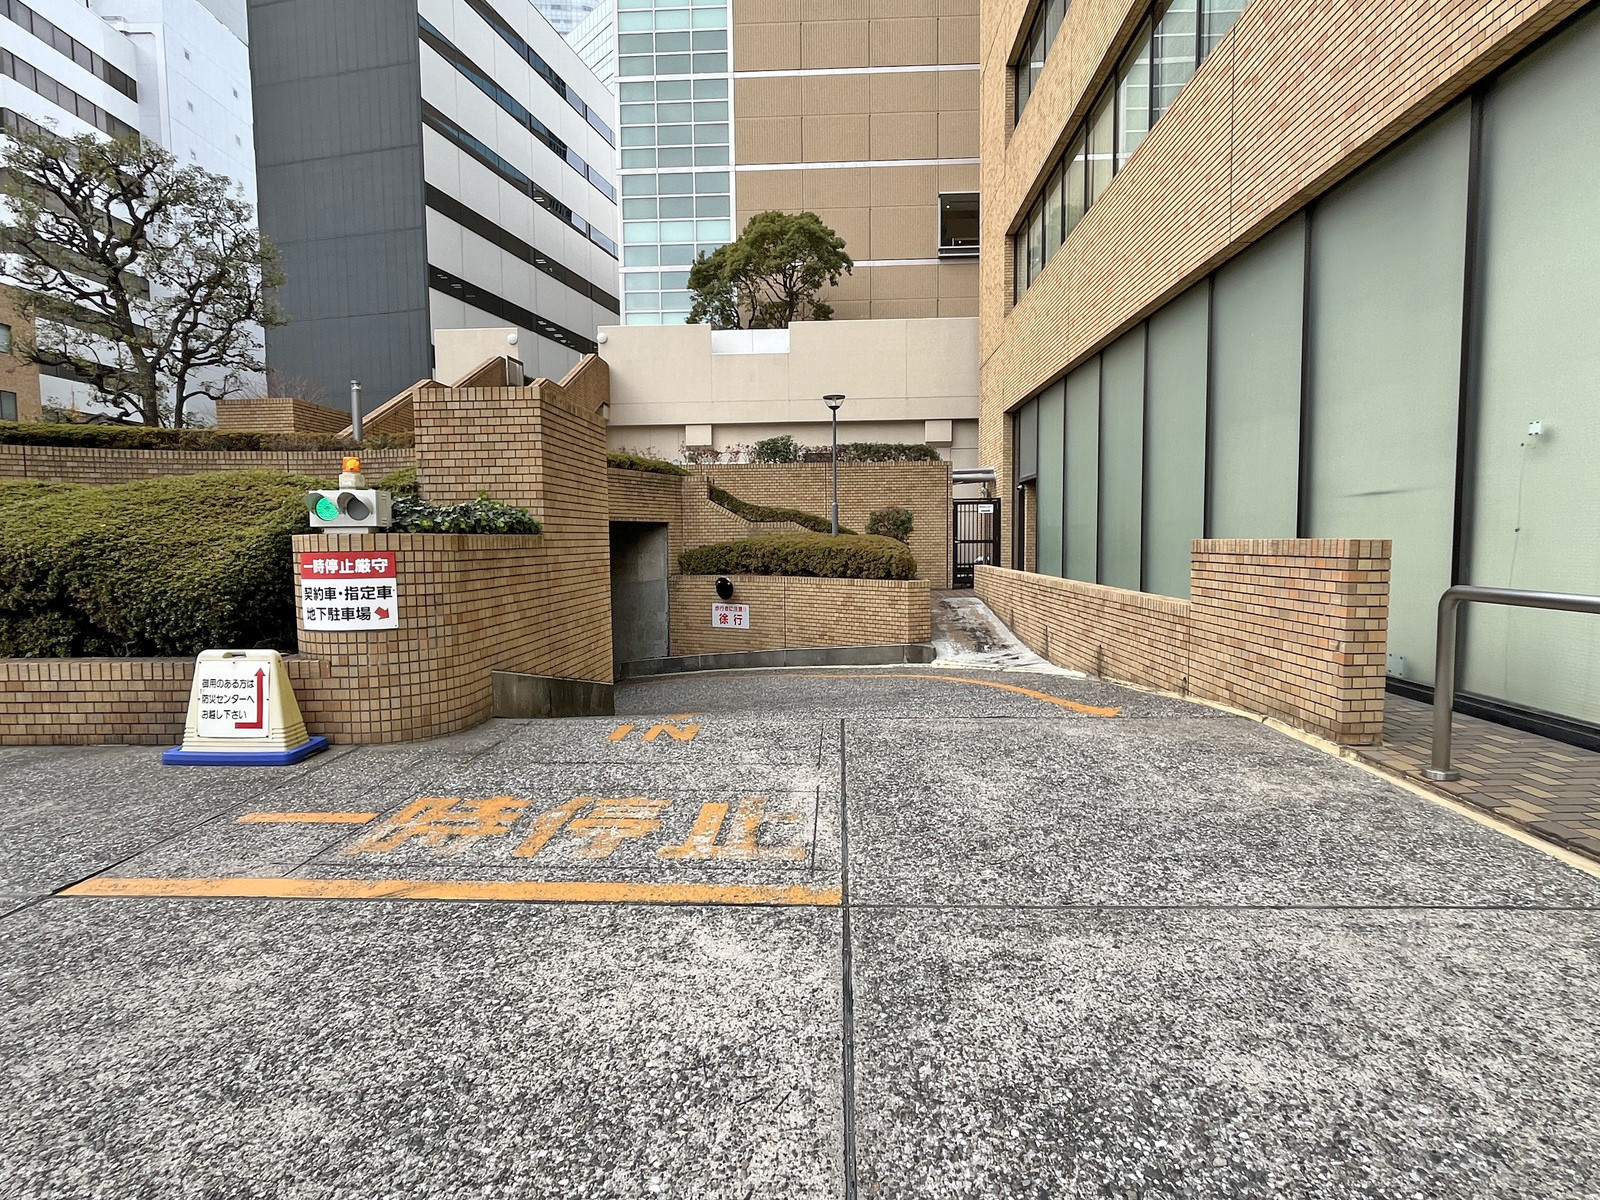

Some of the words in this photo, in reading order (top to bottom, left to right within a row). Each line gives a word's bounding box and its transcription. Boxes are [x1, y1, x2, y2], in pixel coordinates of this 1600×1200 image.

[303, 558, 388, 574] 一時停止厳守
[304, 585, 393, 601] 契約車・指定車
[306, 606, 371, 621] 地下駐車場
[718, 613, 743, 625] 徐行
[202, 678, 254, 689] 御用のある方は
[202, 694, 255, 704] 防災センターへ
[201, 709, 247, 720] お越し下さい
[605, 724, 701, 742] IN
[236, 795, 807, 862] 一時停止
